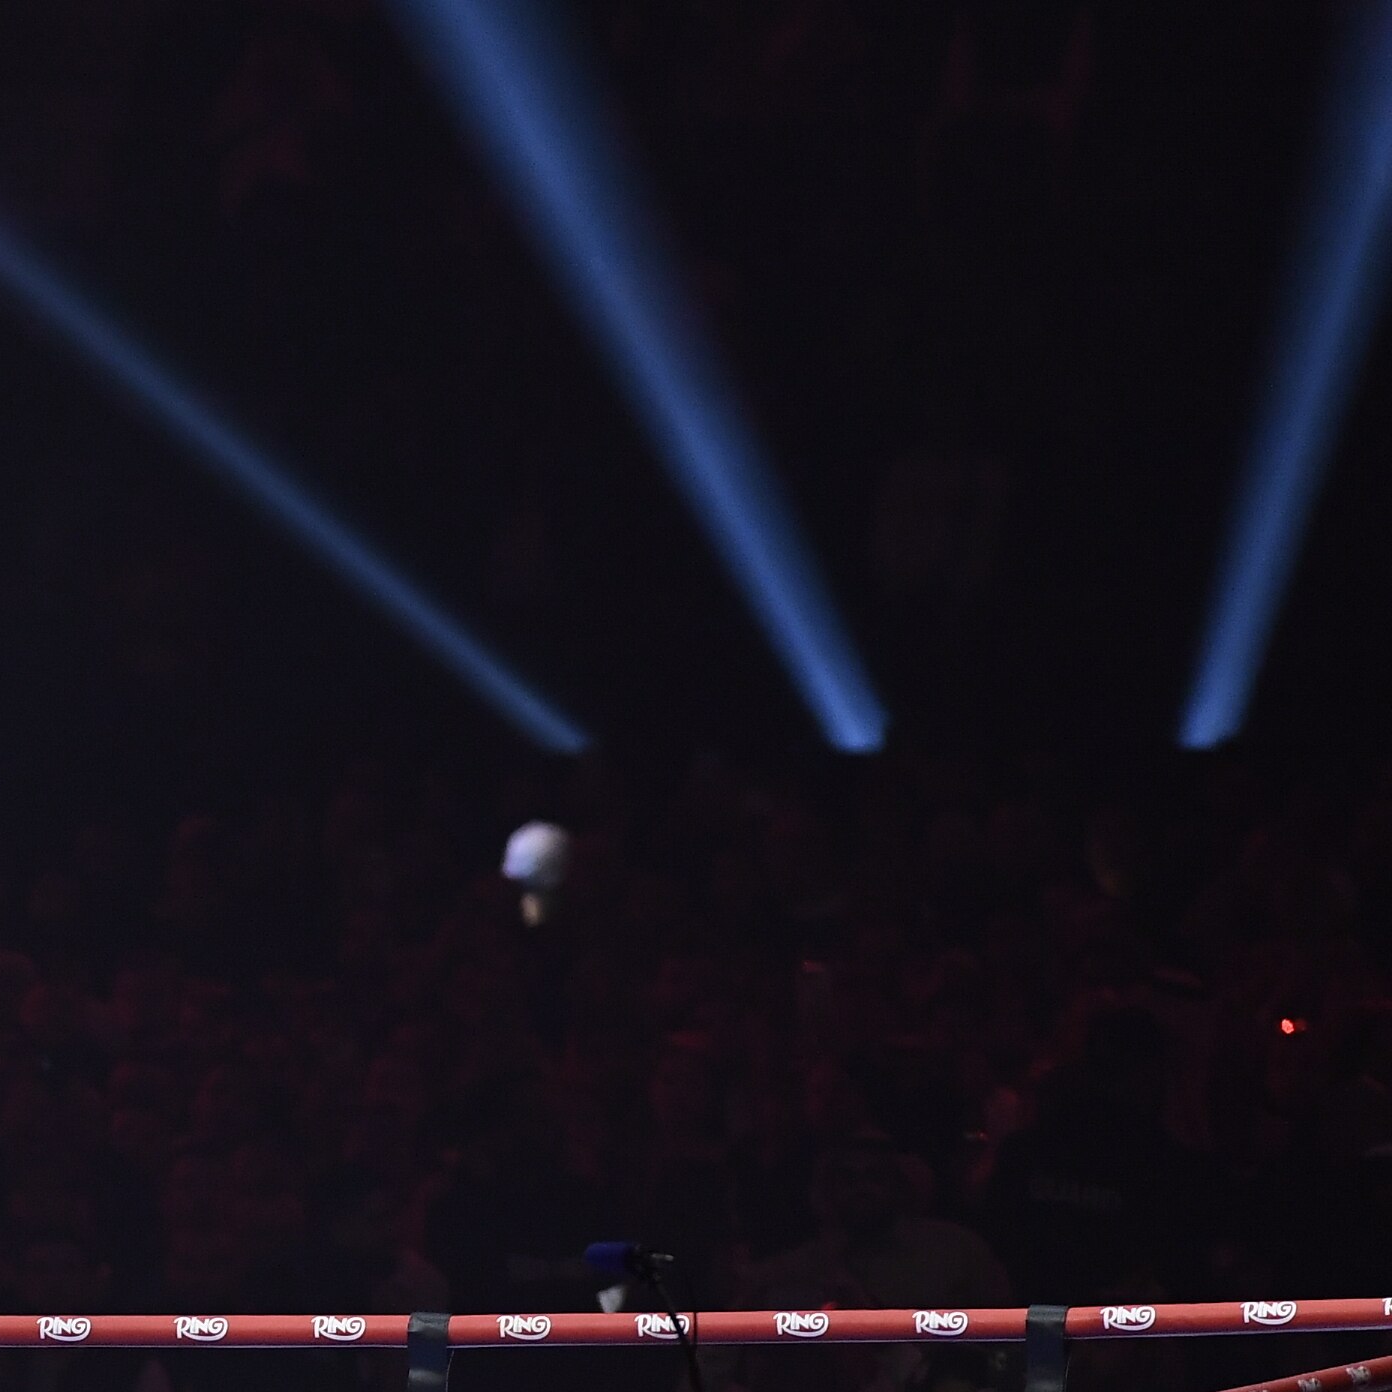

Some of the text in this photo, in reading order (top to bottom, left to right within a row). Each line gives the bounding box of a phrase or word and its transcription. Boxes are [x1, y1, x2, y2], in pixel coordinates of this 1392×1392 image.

[773, 1311, 829, 1337] RING
[912, 1310, 968, 1335] RING
[1100, 1306, 1155, 1331] RING
[1240, 1301, 1296, 1325] RING
[37, 1316, 91, 1341] RING
[174, 1316, 228, 1340] RING
[311, 1315, 366, 1340] RING
[496, 1315, 551, 1339] RING
